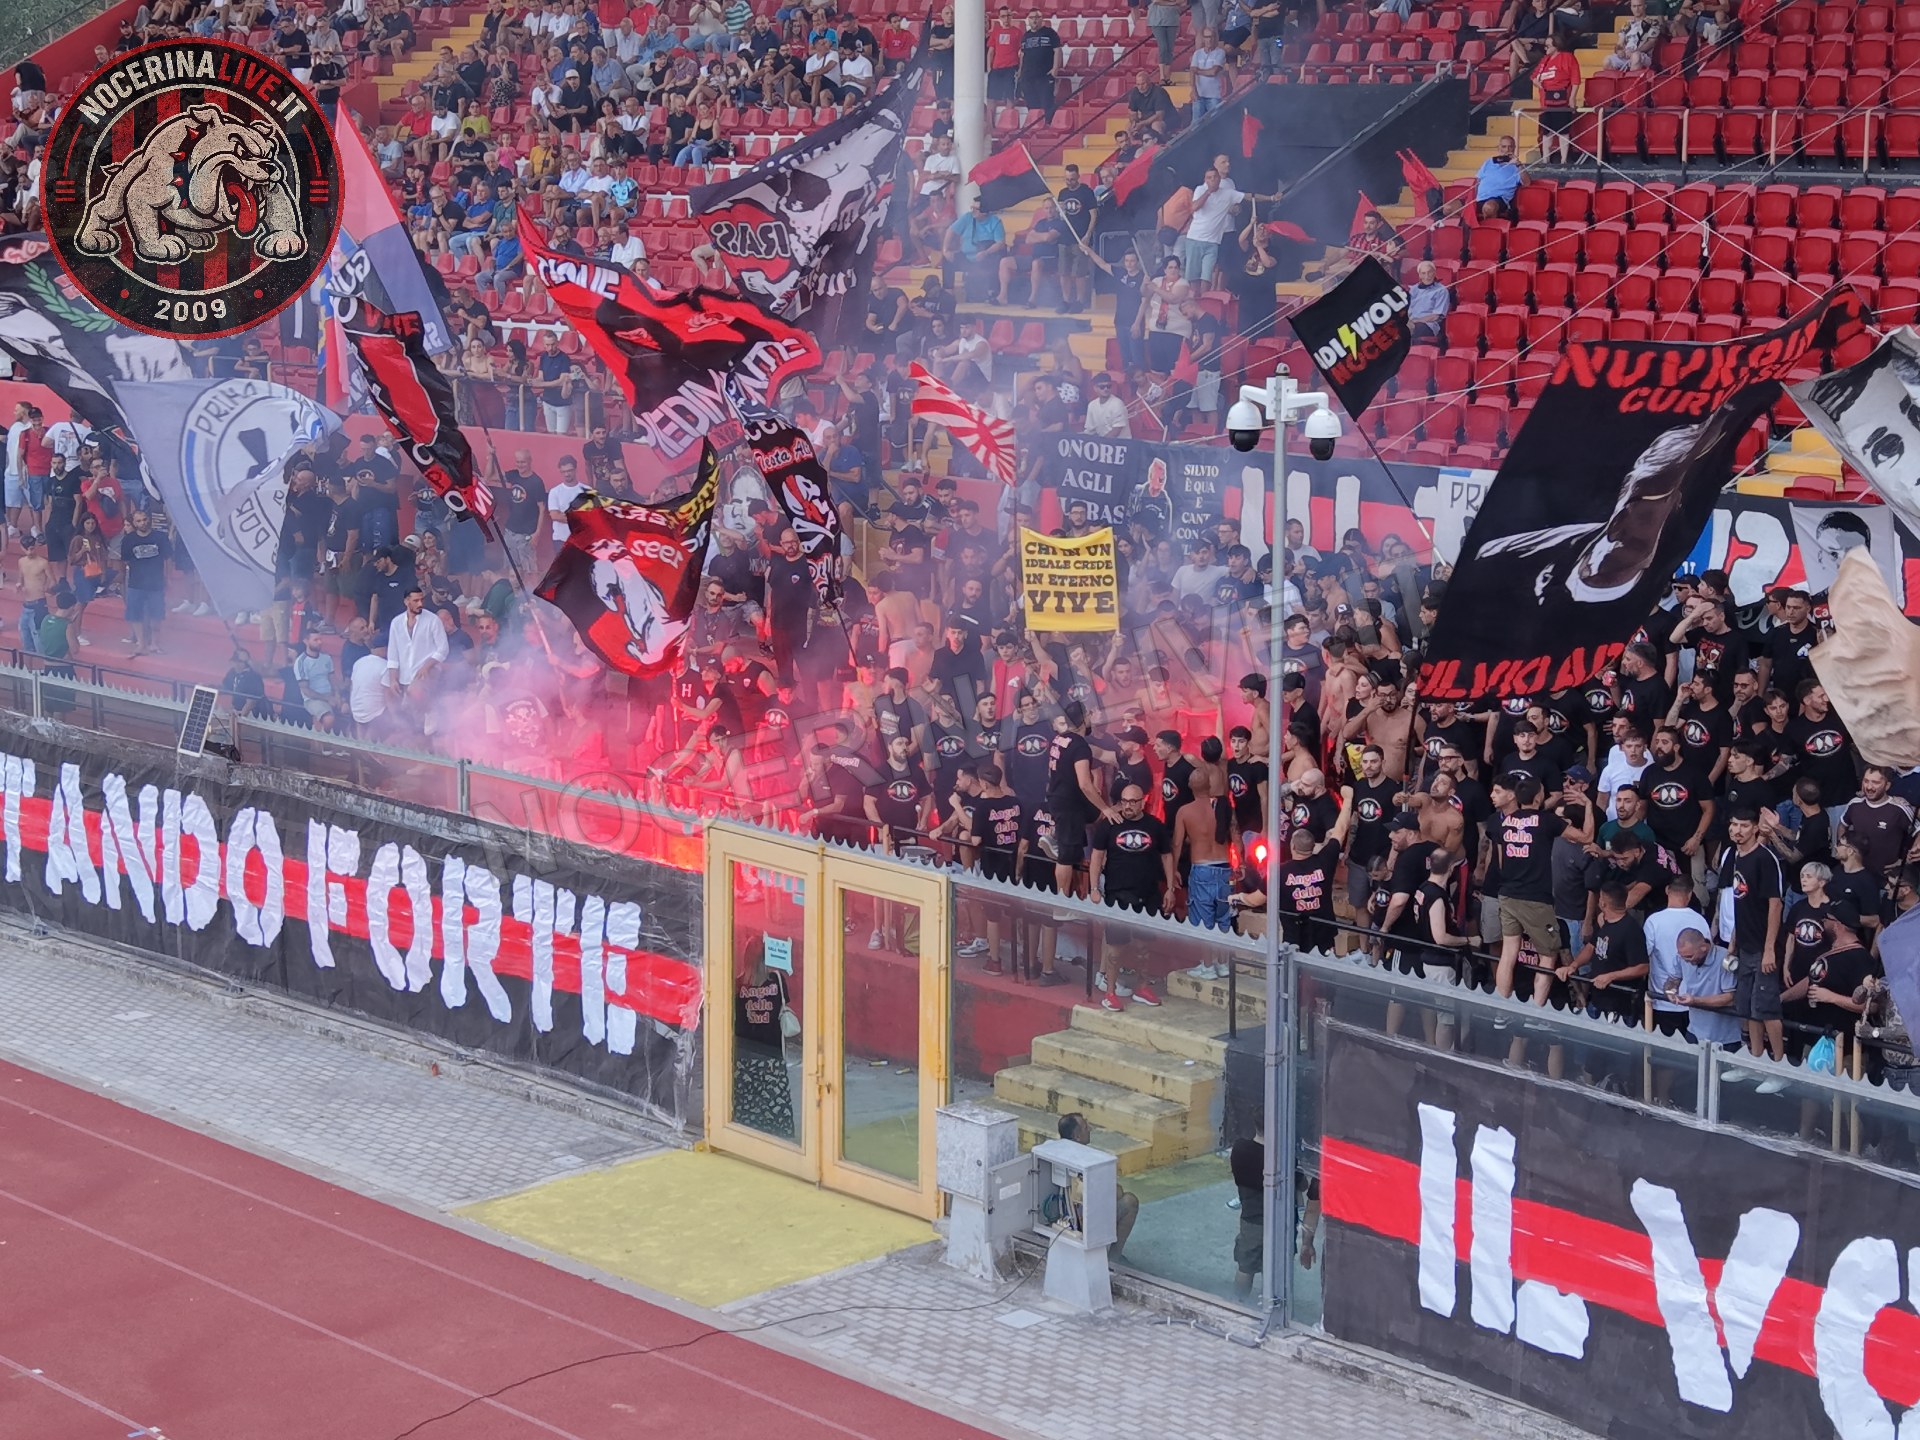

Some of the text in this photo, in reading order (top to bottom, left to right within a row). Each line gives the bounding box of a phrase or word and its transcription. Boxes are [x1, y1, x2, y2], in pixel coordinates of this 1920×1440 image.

[1058, 438, 1127, 466] ONORE
[1184, 464, 1219, 477] SILVIO
[1062, 468, 1113, 494] AGLI
[1194, 481, 1215, 494] QUA
[1196, 497, 1204, 509] E
[1025, 542, 1058, 556] CHI
[1086, 543, 1112, 557] UN
[1026, 558, 1114, 570] IDEALE CREDE
[1026, 573, 1114, 588] IN ETERNO
[1028, 590, 1115, 614] VIVE
[1502, 814, 1539, 829] Angeli
[1503, 830, 1533, 843] della
[1506, 843, 1530, 858] Sud
[1285, 868, 1325, 887] Angeli
[1292, 885, 1323, 901] della
[1296, 898, 1321, 911] Sud
[306, 817, 642, 1056] FORTE
[740, 983, 778, 998] Angeli
[745, 999, 773, 1011] della
[748, 1011, 770, 1023] Sud
[1417, 1102, 1590, 1360] IL
